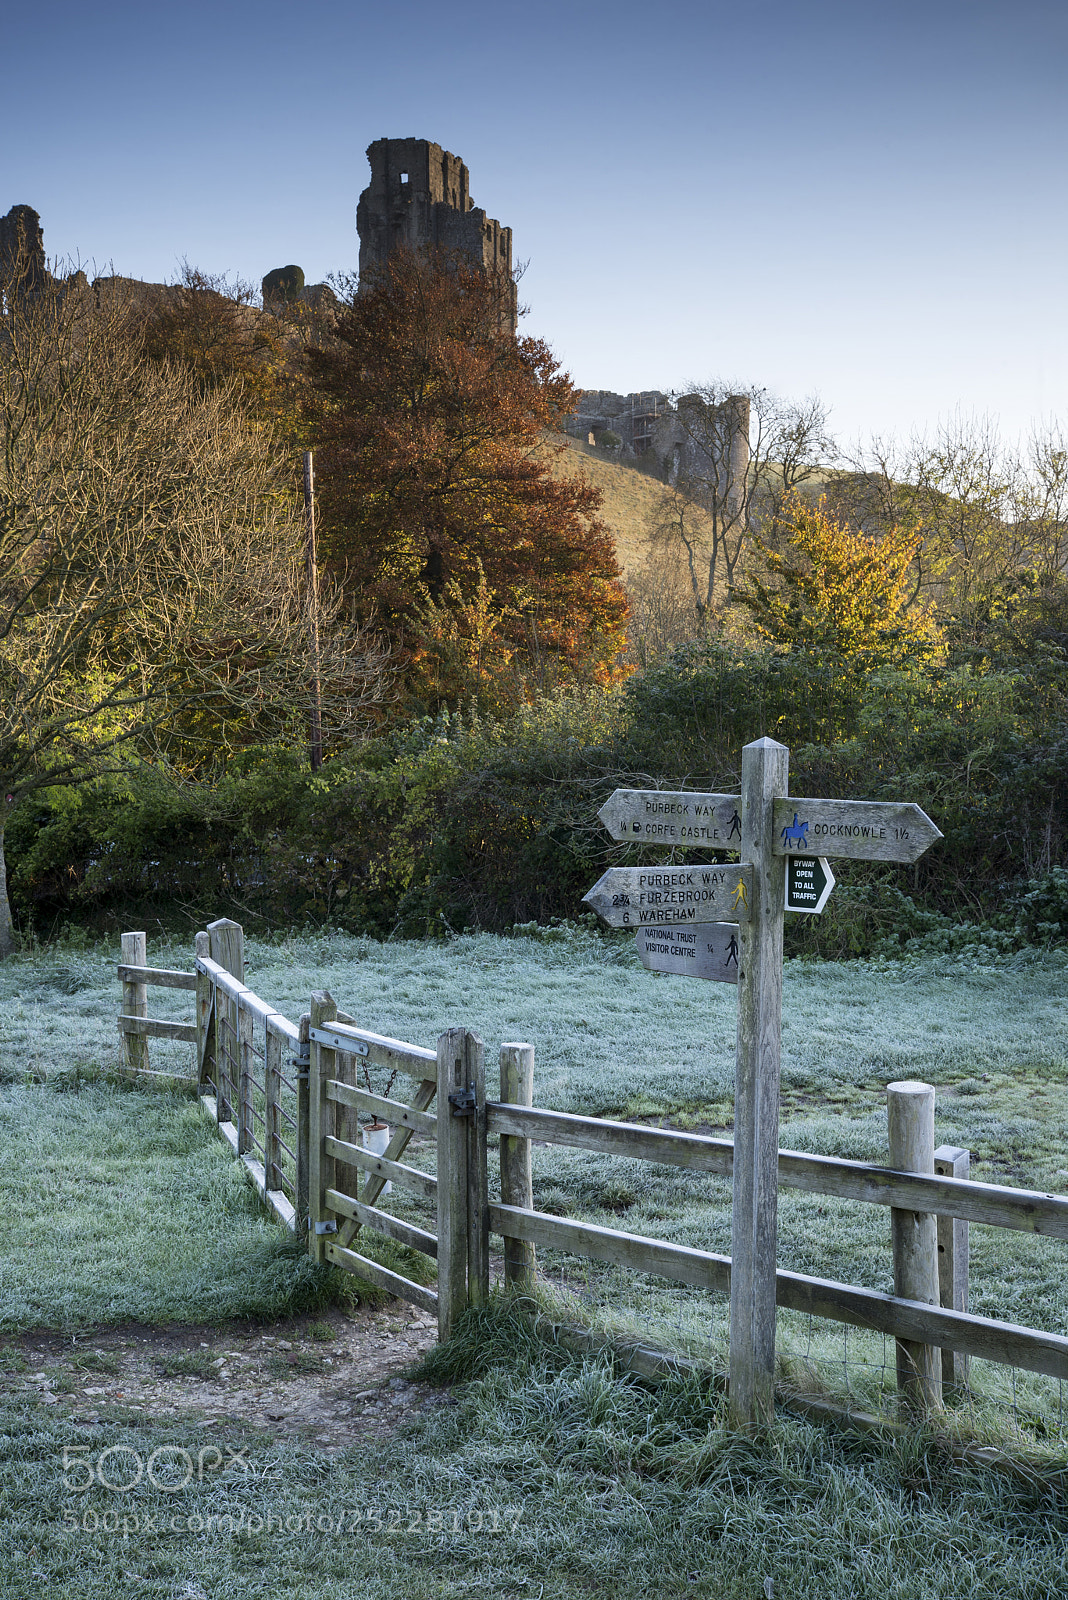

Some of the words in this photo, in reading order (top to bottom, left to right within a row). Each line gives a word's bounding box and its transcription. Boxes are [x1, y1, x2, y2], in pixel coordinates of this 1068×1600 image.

[645, 802, 689, 815] PURBECK
[695, 805, 716, 817] WAY
[645, 823, 676, 836] CORFE
[680, 826, 719, 839] CASTLE
[814, 823, 887, 839] COCKNOWLE
[793, 860, 816, 868] BYWAY
[639, 873, 693, 886] PURBECK
[701, 872, 726, 885] WAY
[796, 870, 813, 878] OPEN
[794, 881, 803, 889] TO
[803, 882, 815, 890] ALL
[639, 890, 716, 904] FURZEBROOK
[792, 891, 817, 901] TRAFFIC
[622, 912, 630, 923] 6
[639, 908, 696, 922] WAREHAM
[644, 929, 675, 942] NATIONAL
[676, 932, 697, 944] TRUST
[645, 942, 670, 954] VISITOR
[670, 945, 696, 958] CENTRE
